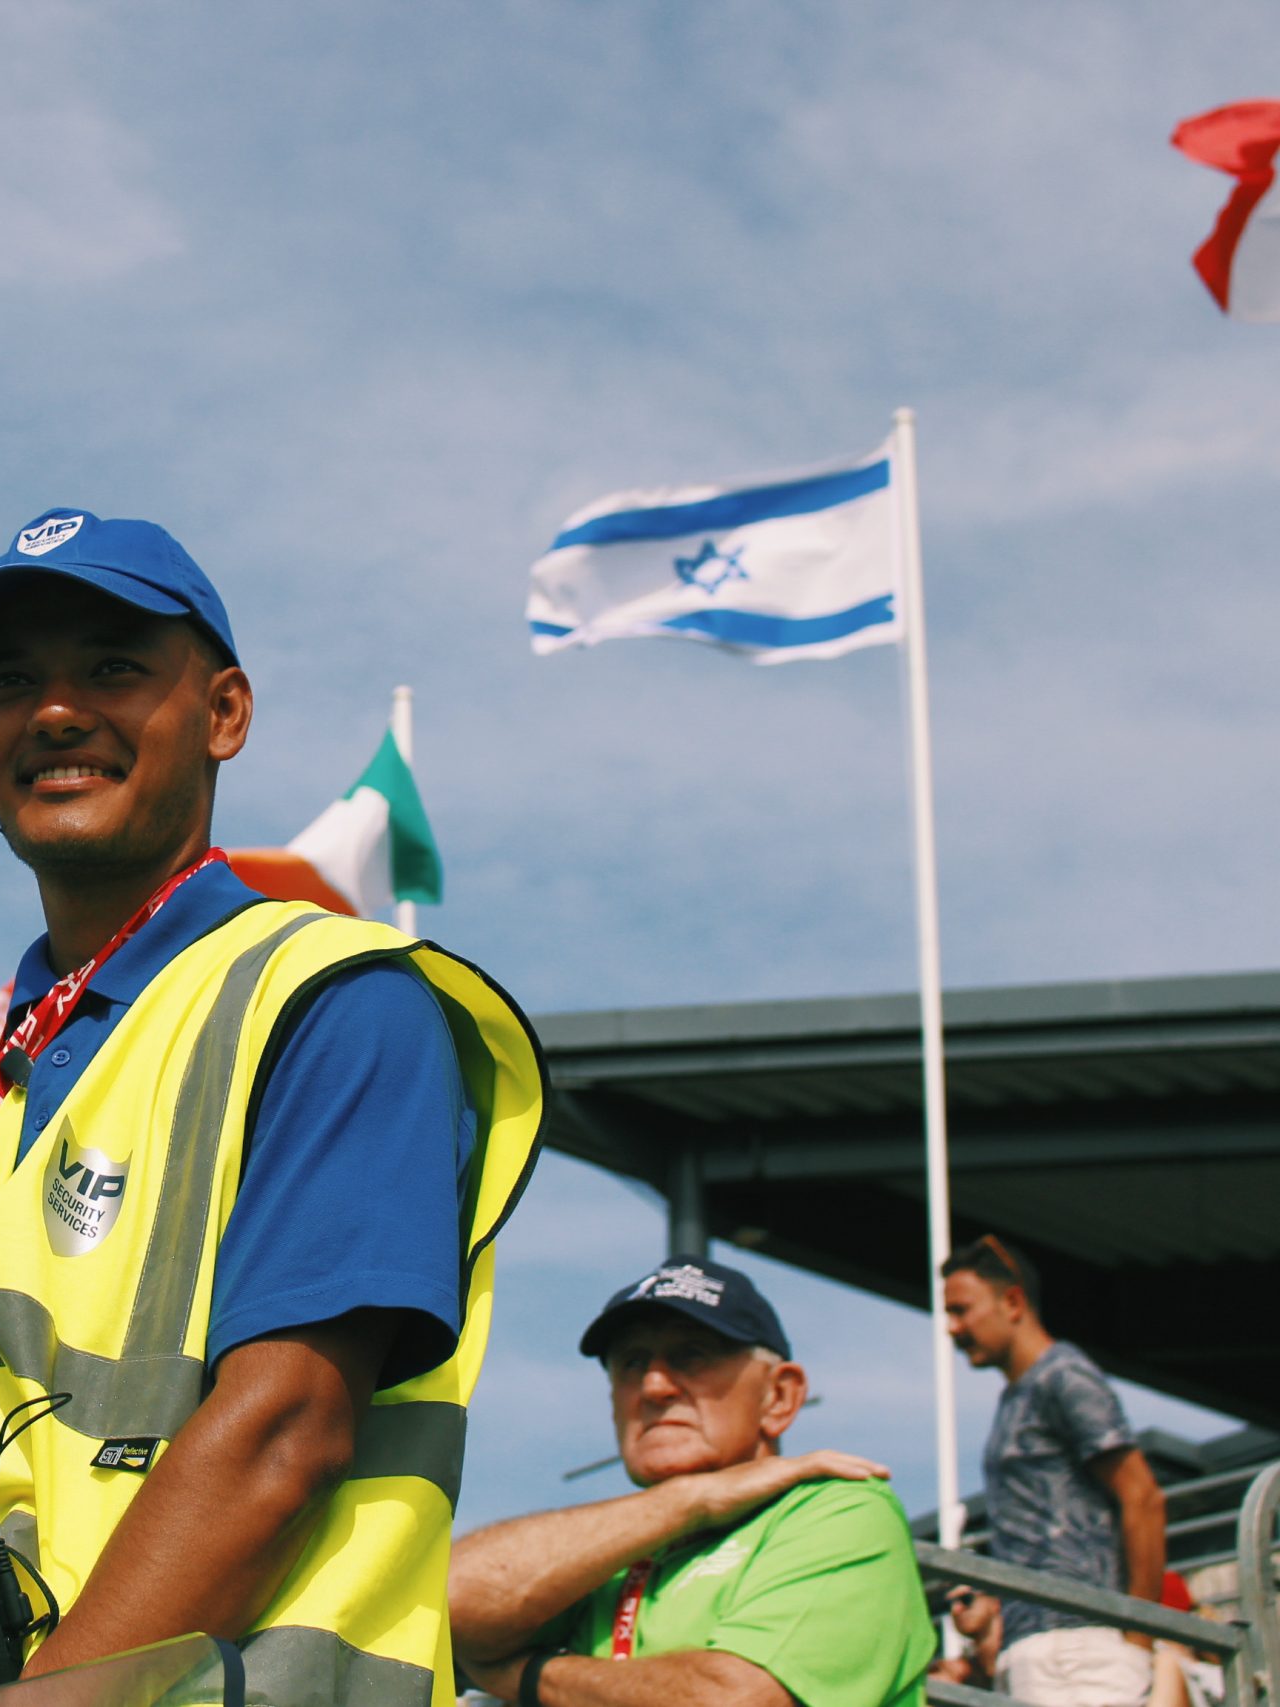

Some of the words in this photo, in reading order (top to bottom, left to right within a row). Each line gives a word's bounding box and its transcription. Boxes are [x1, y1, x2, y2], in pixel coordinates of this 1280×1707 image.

[23, 520, 78, 541] VIP
[58, 1137, 125, 1201] VIP
[47, 1191, 99, 1239] SERVICES
[52, 1178, 106, 1223] SECURITY
[123, 1446, 149, 1456] Reflective
